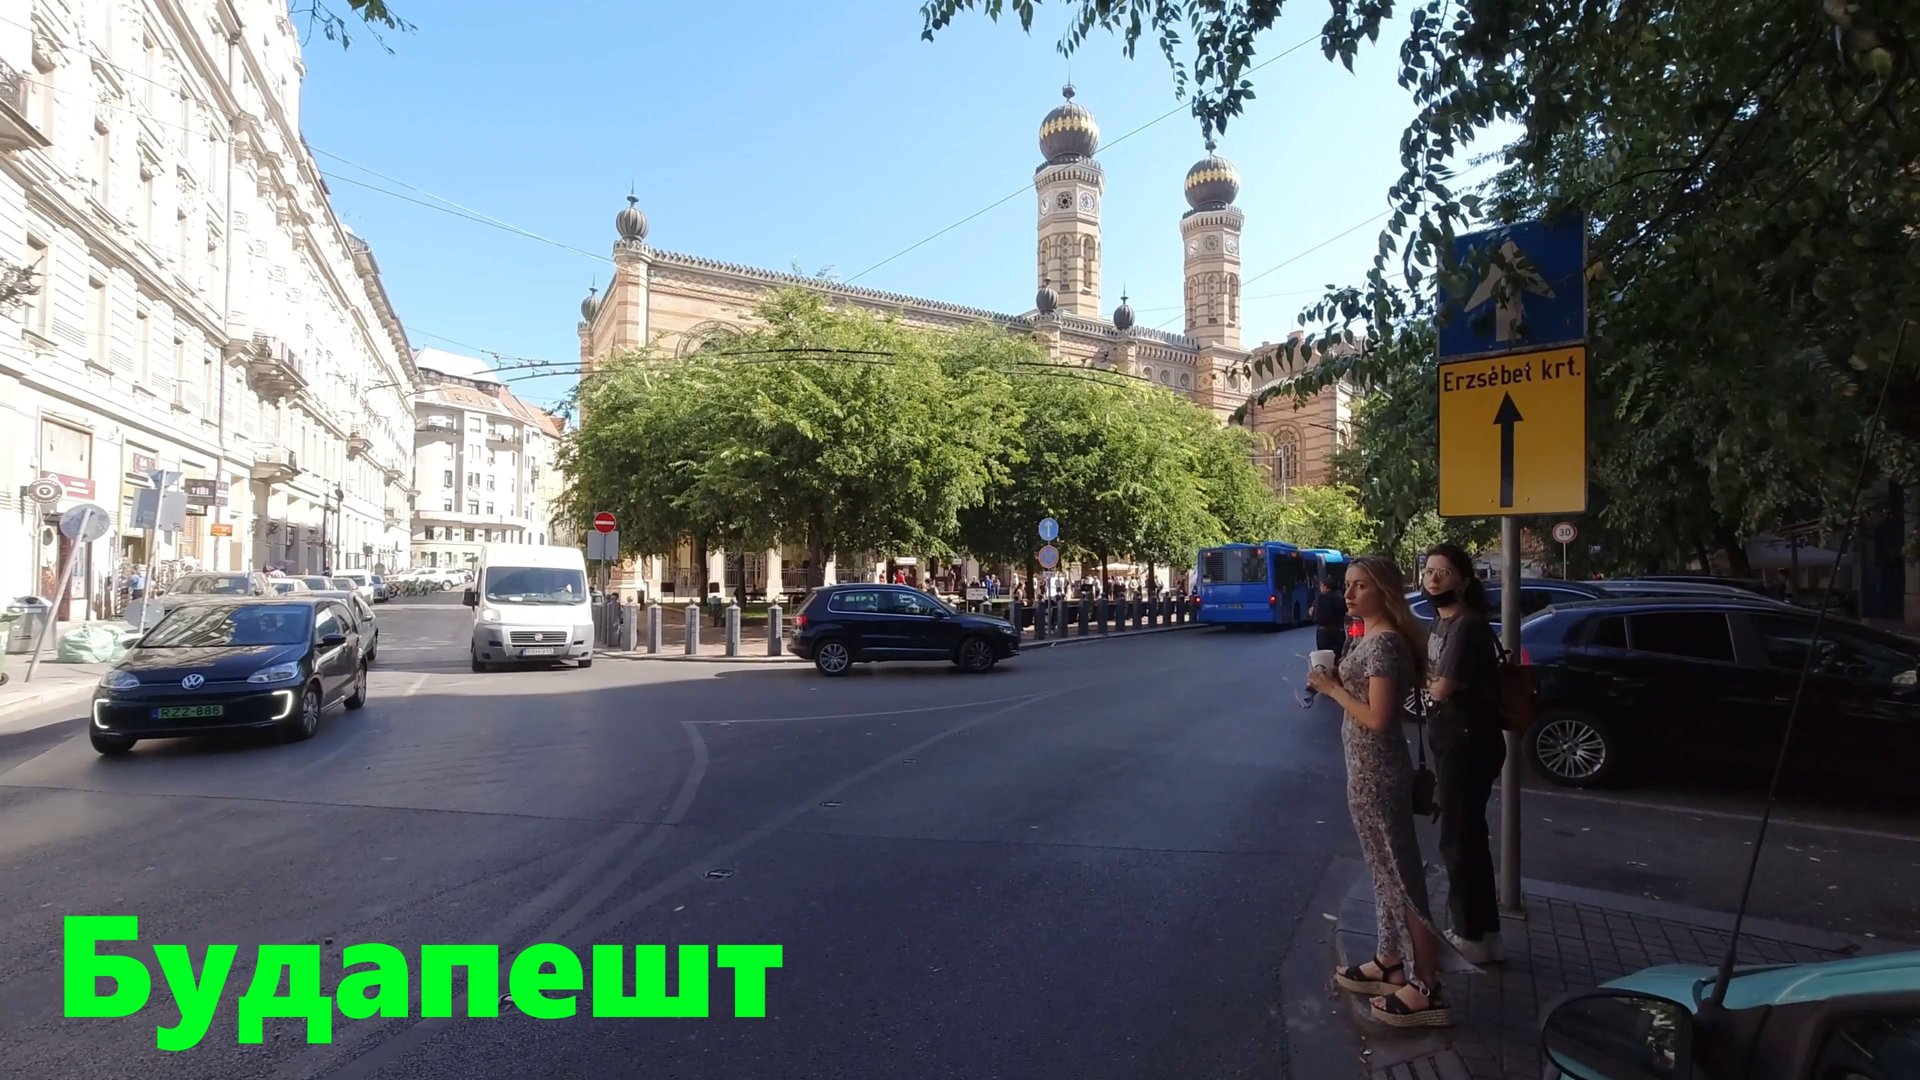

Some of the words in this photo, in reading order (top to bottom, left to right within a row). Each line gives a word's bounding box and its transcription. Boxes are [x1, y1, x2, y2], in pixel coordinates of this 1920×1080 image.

[1444, 362, 1532, 392] Erzsébet
[1542, 356, 1581, 381] krt.
[1559, 528, 1571, 537] 30
